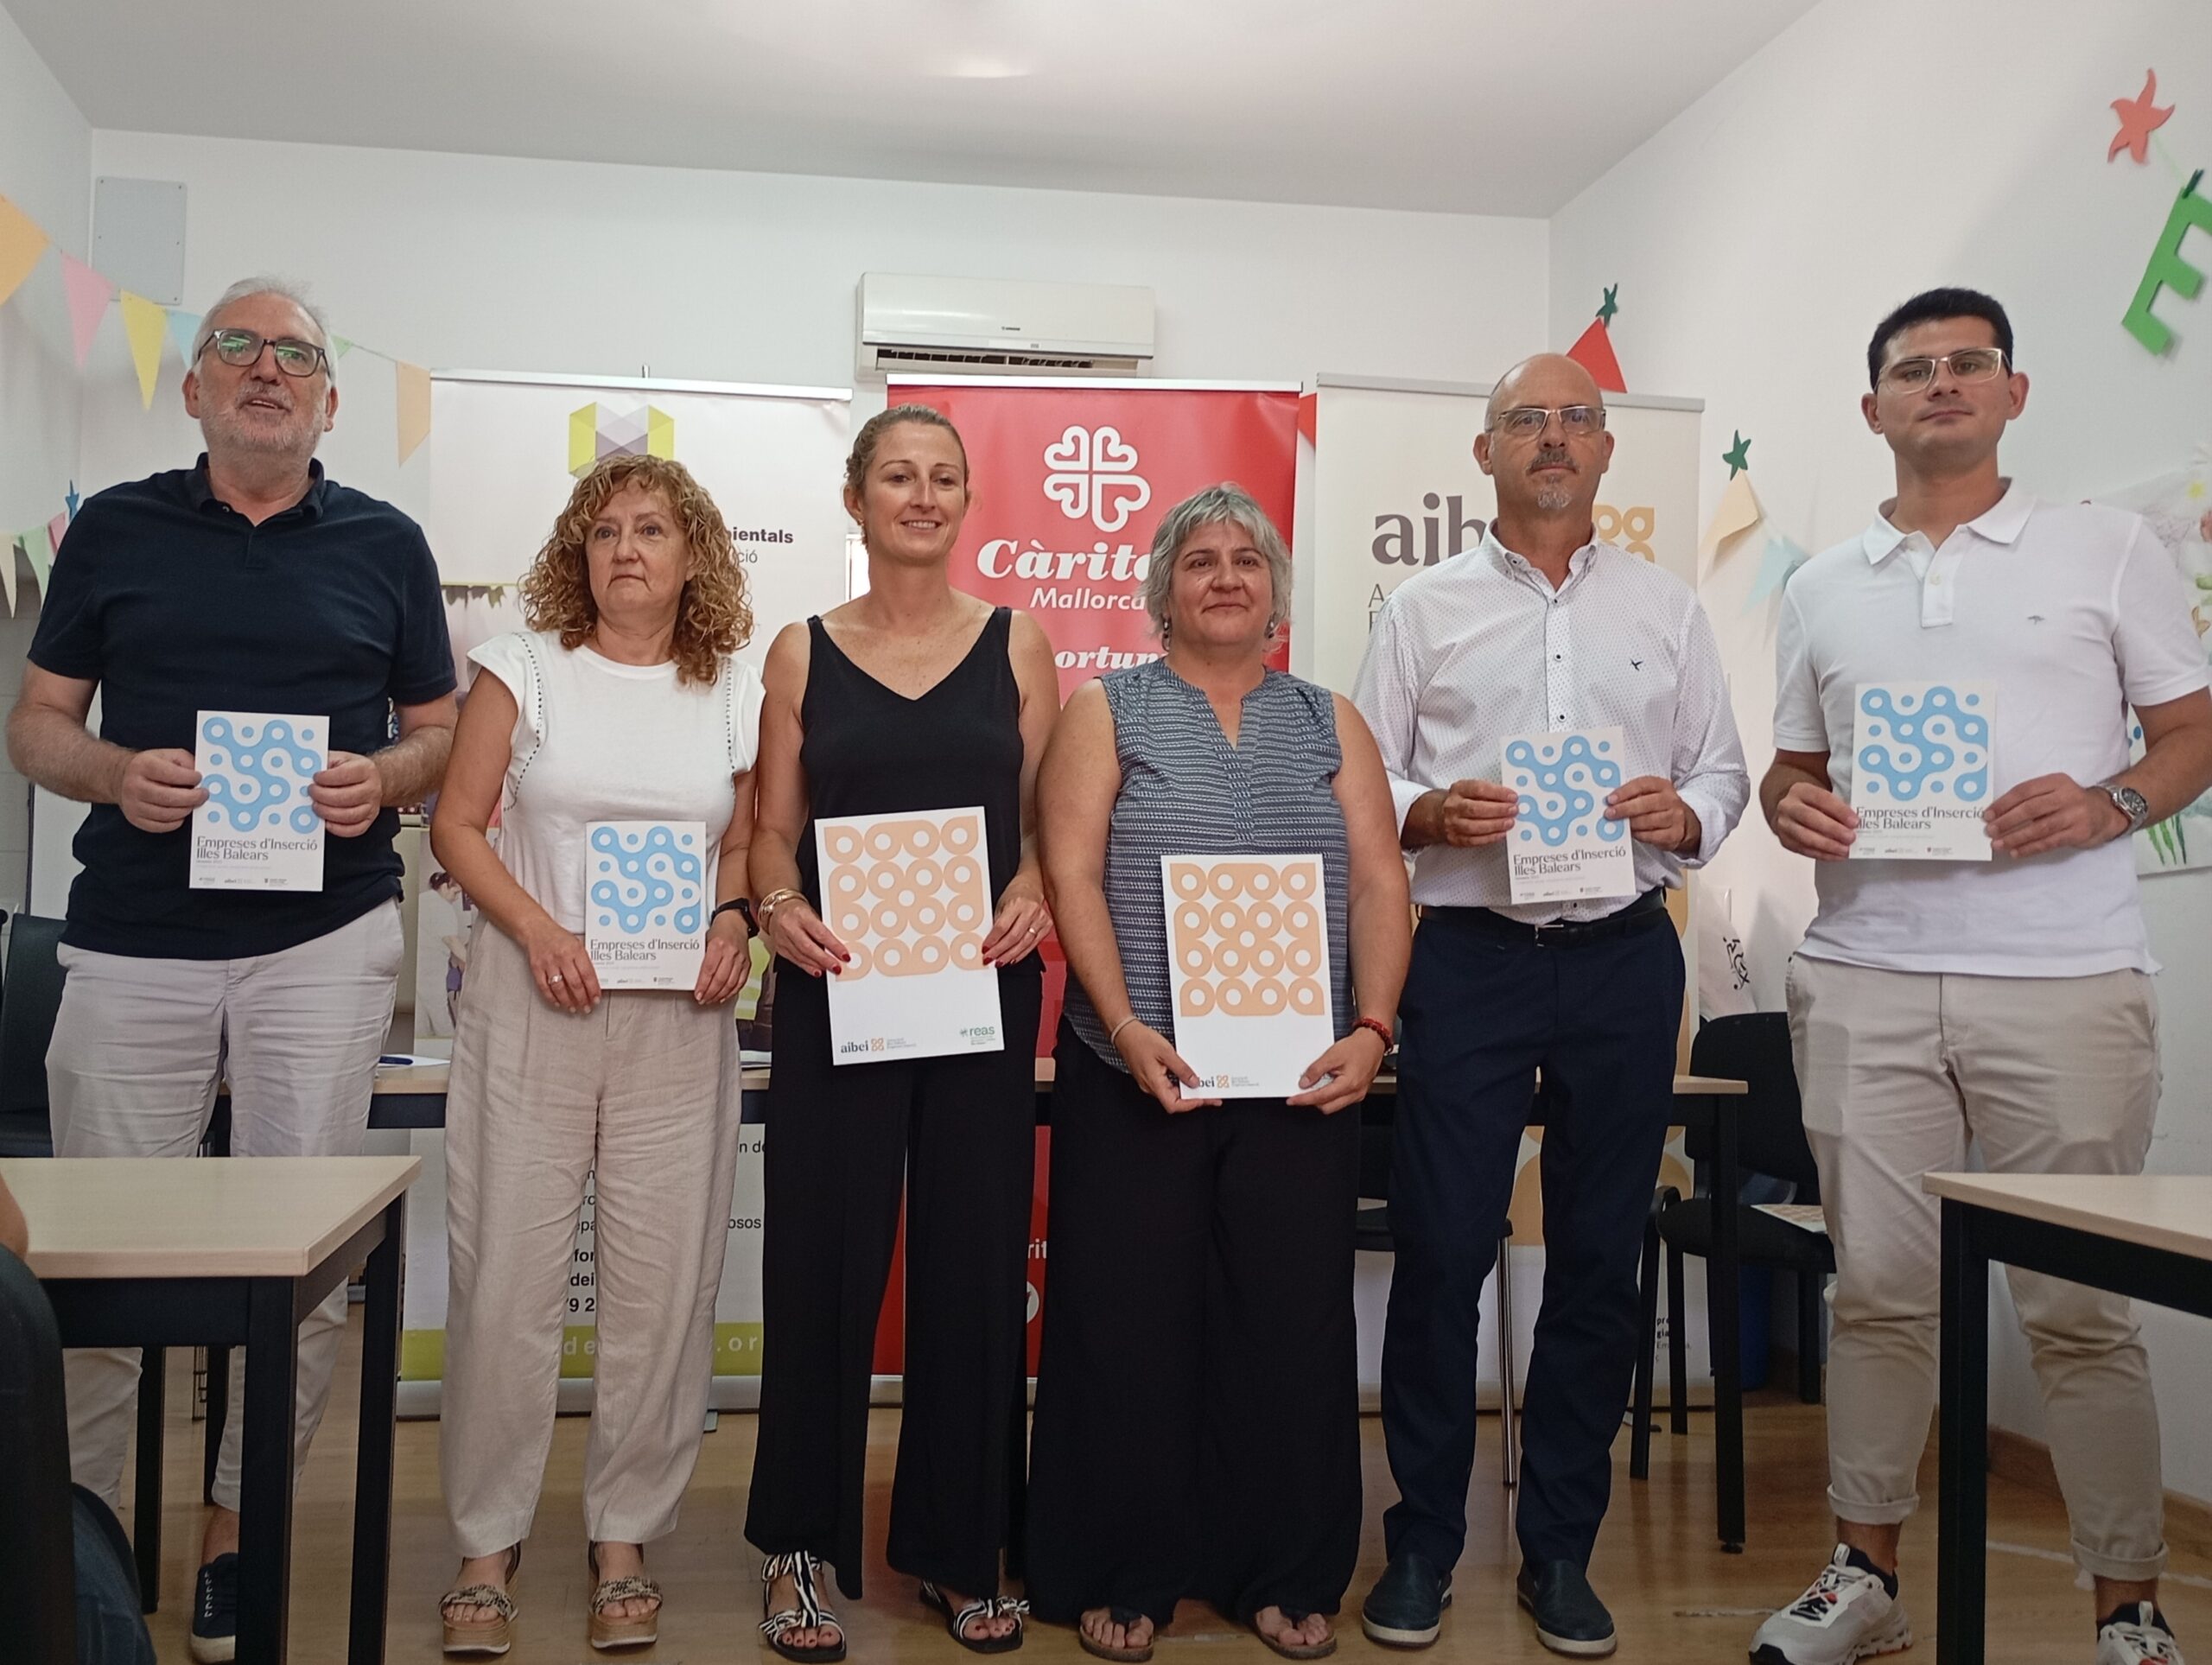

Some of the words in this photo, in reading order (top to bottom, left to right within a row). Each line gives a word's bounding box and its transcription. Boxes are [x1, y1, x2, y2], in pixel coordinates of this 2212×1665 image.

[1030, 588, 1146, 609] Mallorca
[1856, 807, 1918, 820] Empreses
[1922, 807, 1985, 818] d'Inserció
[1883, 818, 1931, 829] Balears
[197, 836, 257, 850] Empreses
[259, 838, 318, 851] d'Inserció
[196, 848, 219, 860] Illes
[223, 848, 269, 861] Balears
[1514, 854, 1568, 866] Empreses
[1571, 846, 1626, 861] d'Inserció
[1515, 865, 1536, 876] Illes
[1539, 862, 1581, 874] Balears
[590, 939, 645, 952] Empreses
[648, 939, 700, 950] d'Inserció
[590, 950, 612, 961] Illes
[614, 950, 657, 961] Balears
[969, 1026, 995, 1037] reas
[841, 1040, 869, 1053] aibei
